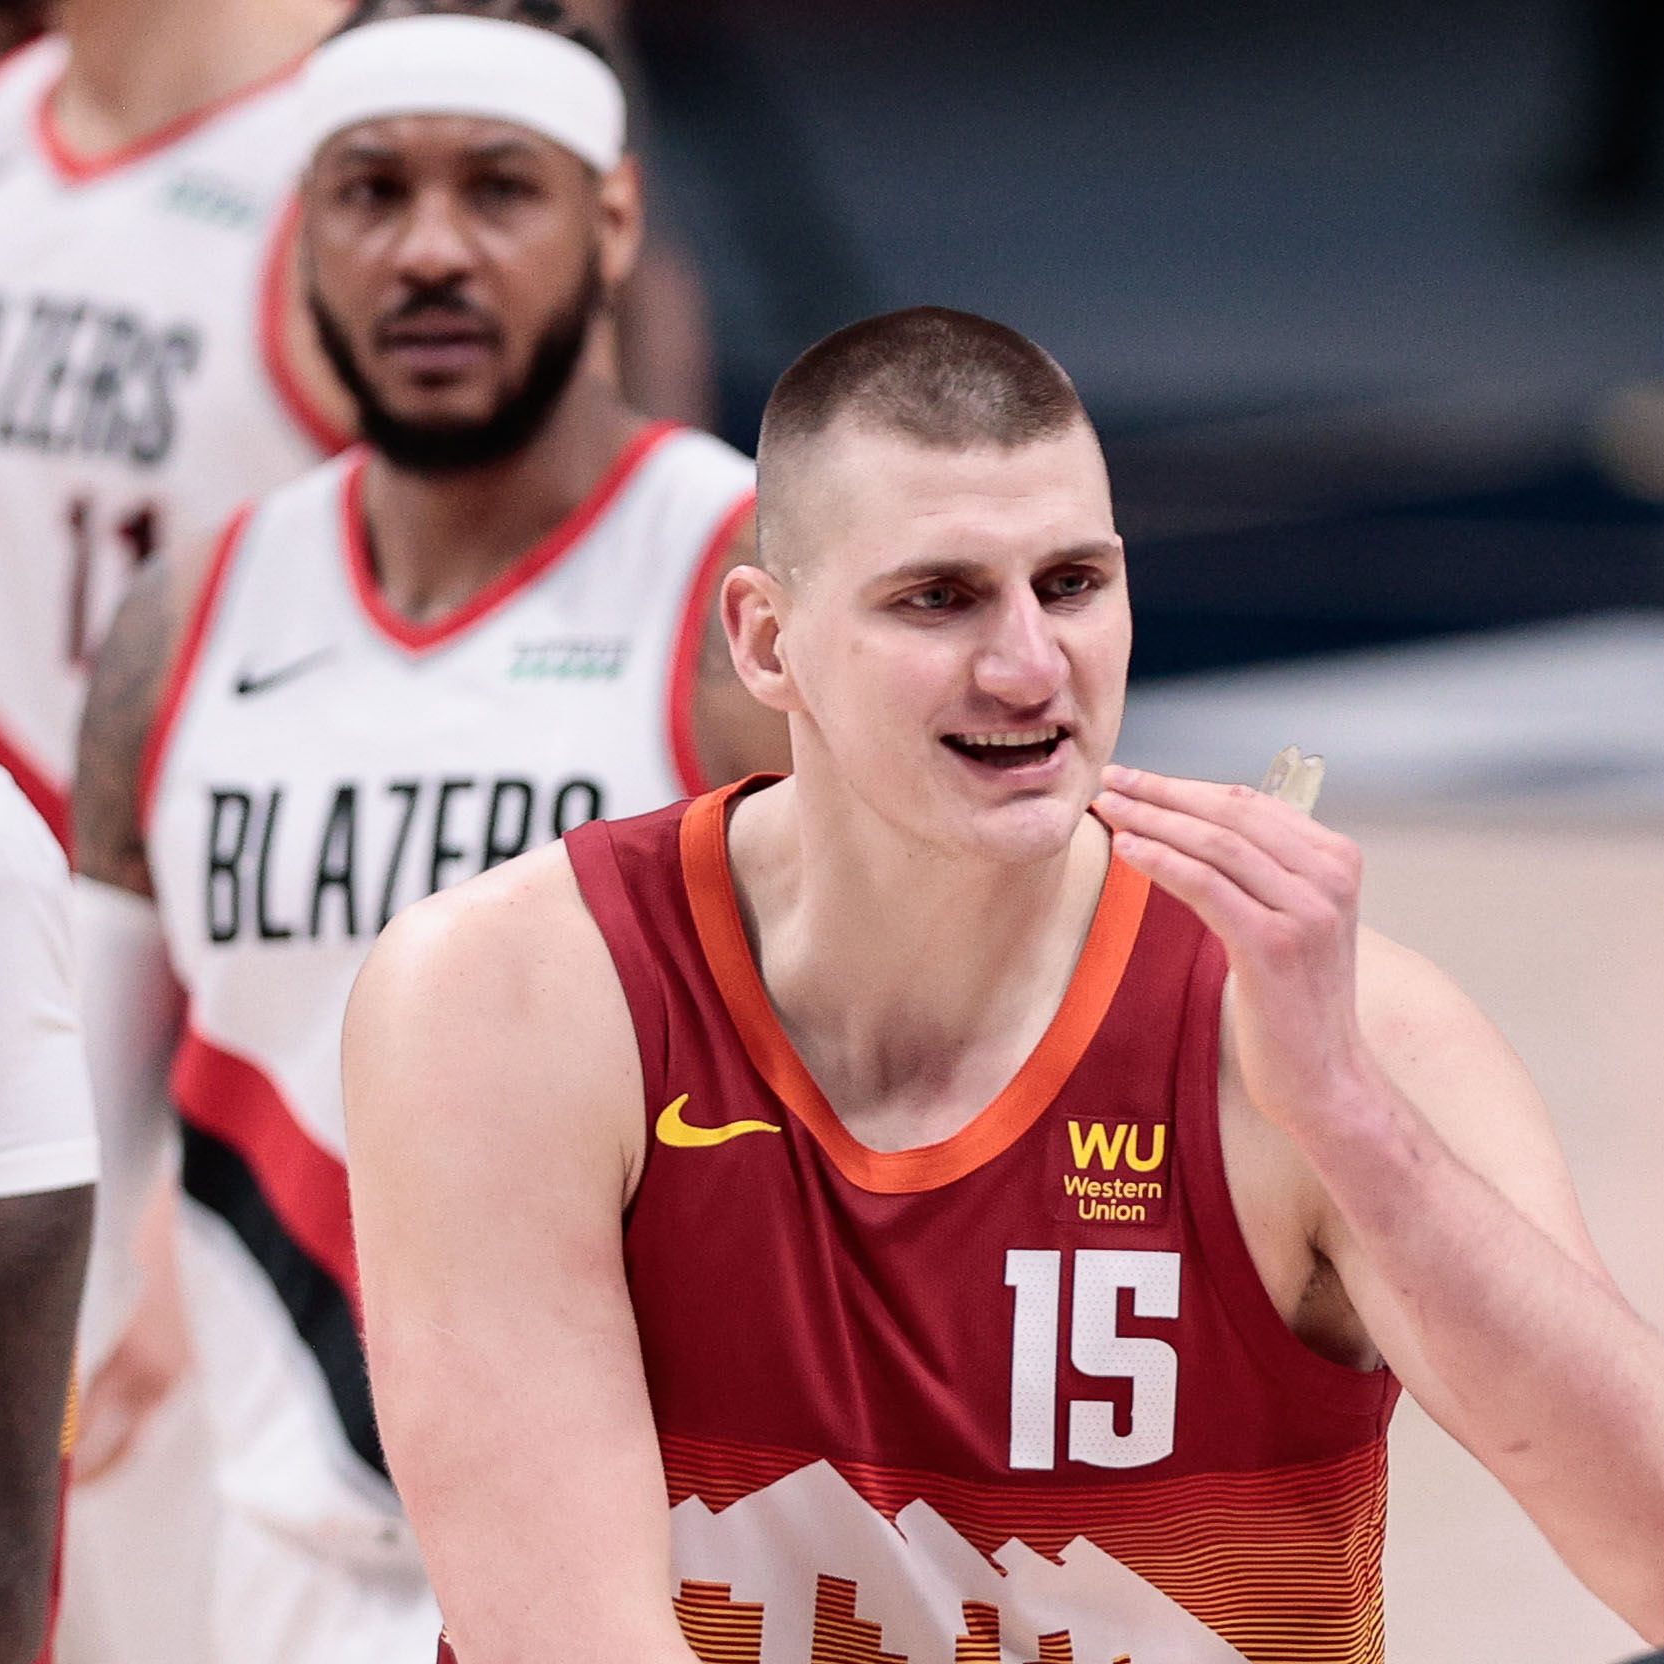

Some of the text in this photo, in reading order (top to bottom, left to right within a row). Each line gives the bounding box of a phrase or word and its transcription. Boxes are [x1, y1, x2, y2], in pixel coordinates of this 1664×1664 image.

[1067, 1120, 1166, 1172] WU
[1063, 1174, 1162, 1199] Western
[1078, 1198, 1146, 1221] Union
[1004, 1248, 1181, 1470] 15
